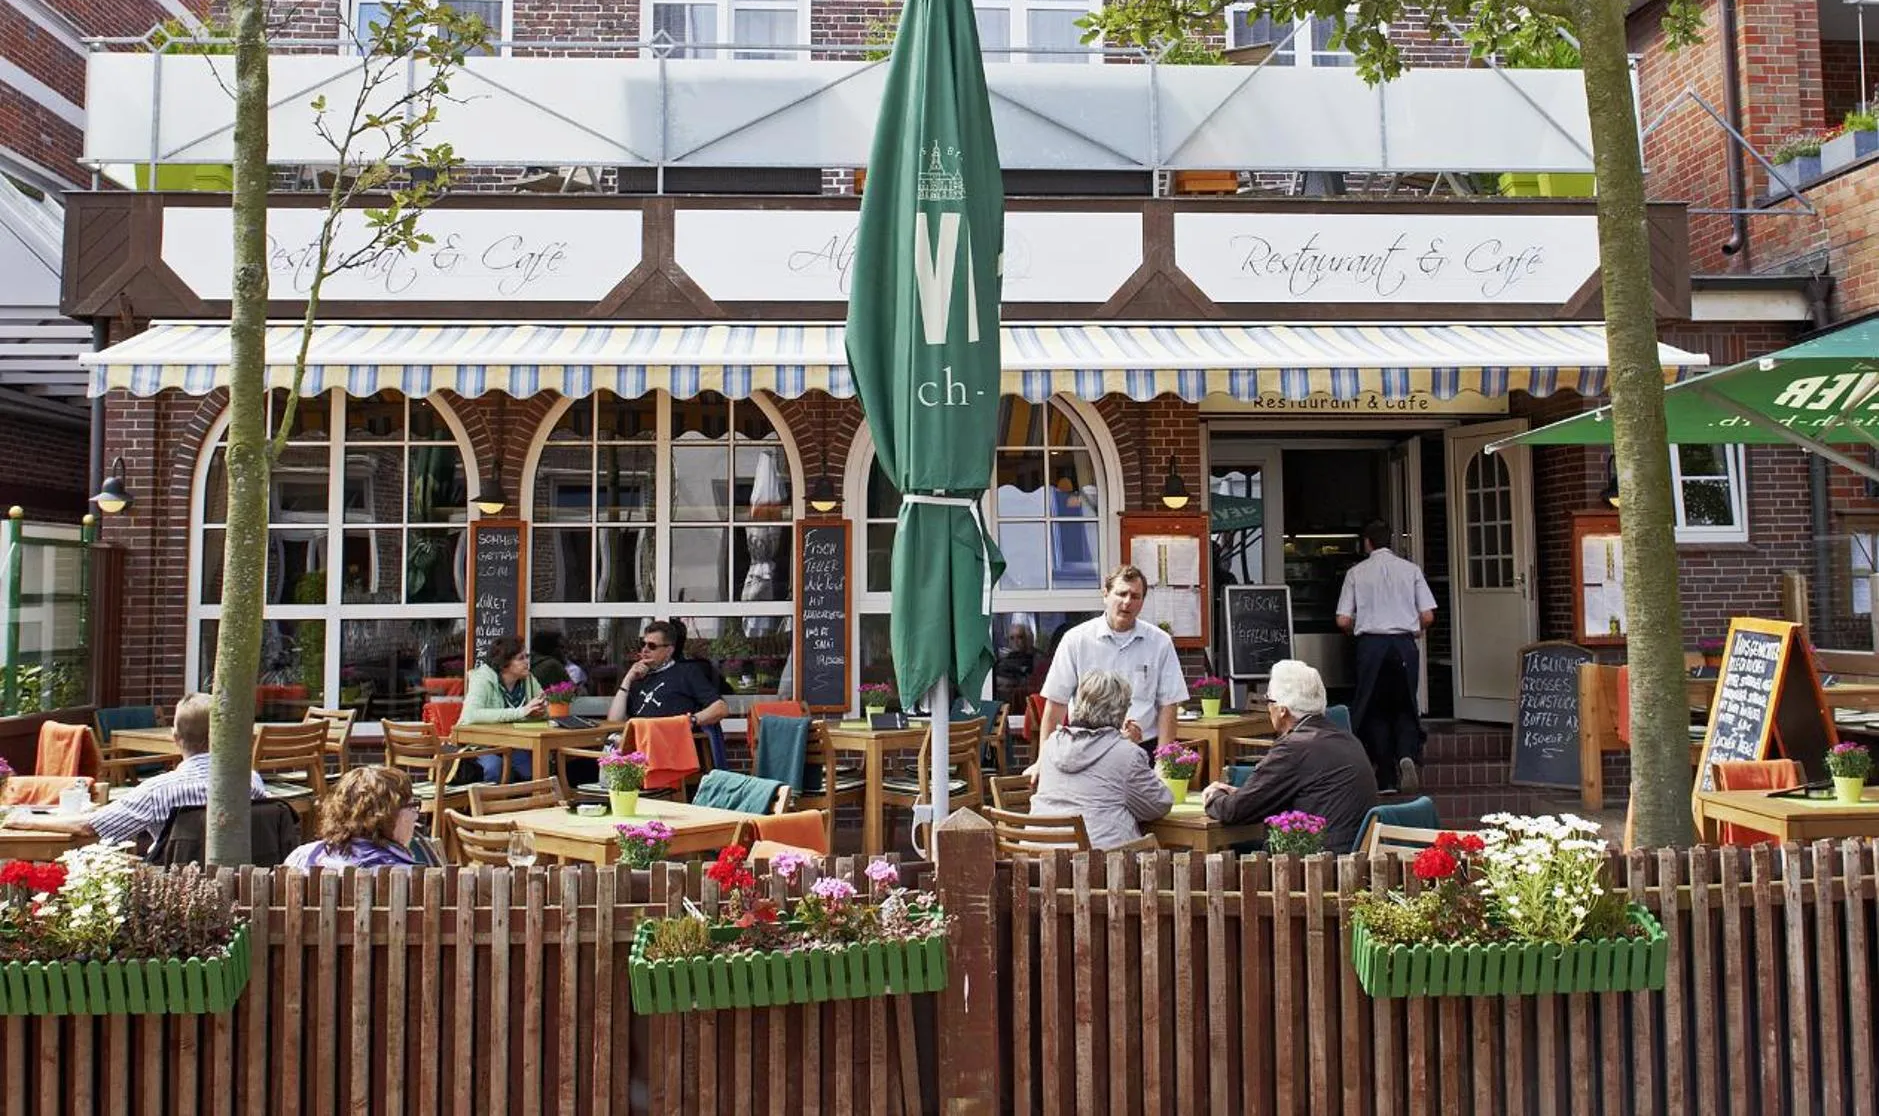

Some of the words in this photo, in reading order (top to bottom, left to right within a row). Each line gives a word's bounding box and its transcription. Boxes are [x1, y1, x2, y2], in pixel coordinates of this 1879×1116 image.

[431, 233, 463, 270] &
[482, 235, 567, 296] Café
[1230, 233, 1407, 297] Restaurant
[1416, 237, 1448, 275] &
[1464, 238, 1544, 297] Café
[1367, 395, 1378, 409] &
[803, 529, 837, 556] FISCH
[1521, 677, 1572, 692] GROSSES
